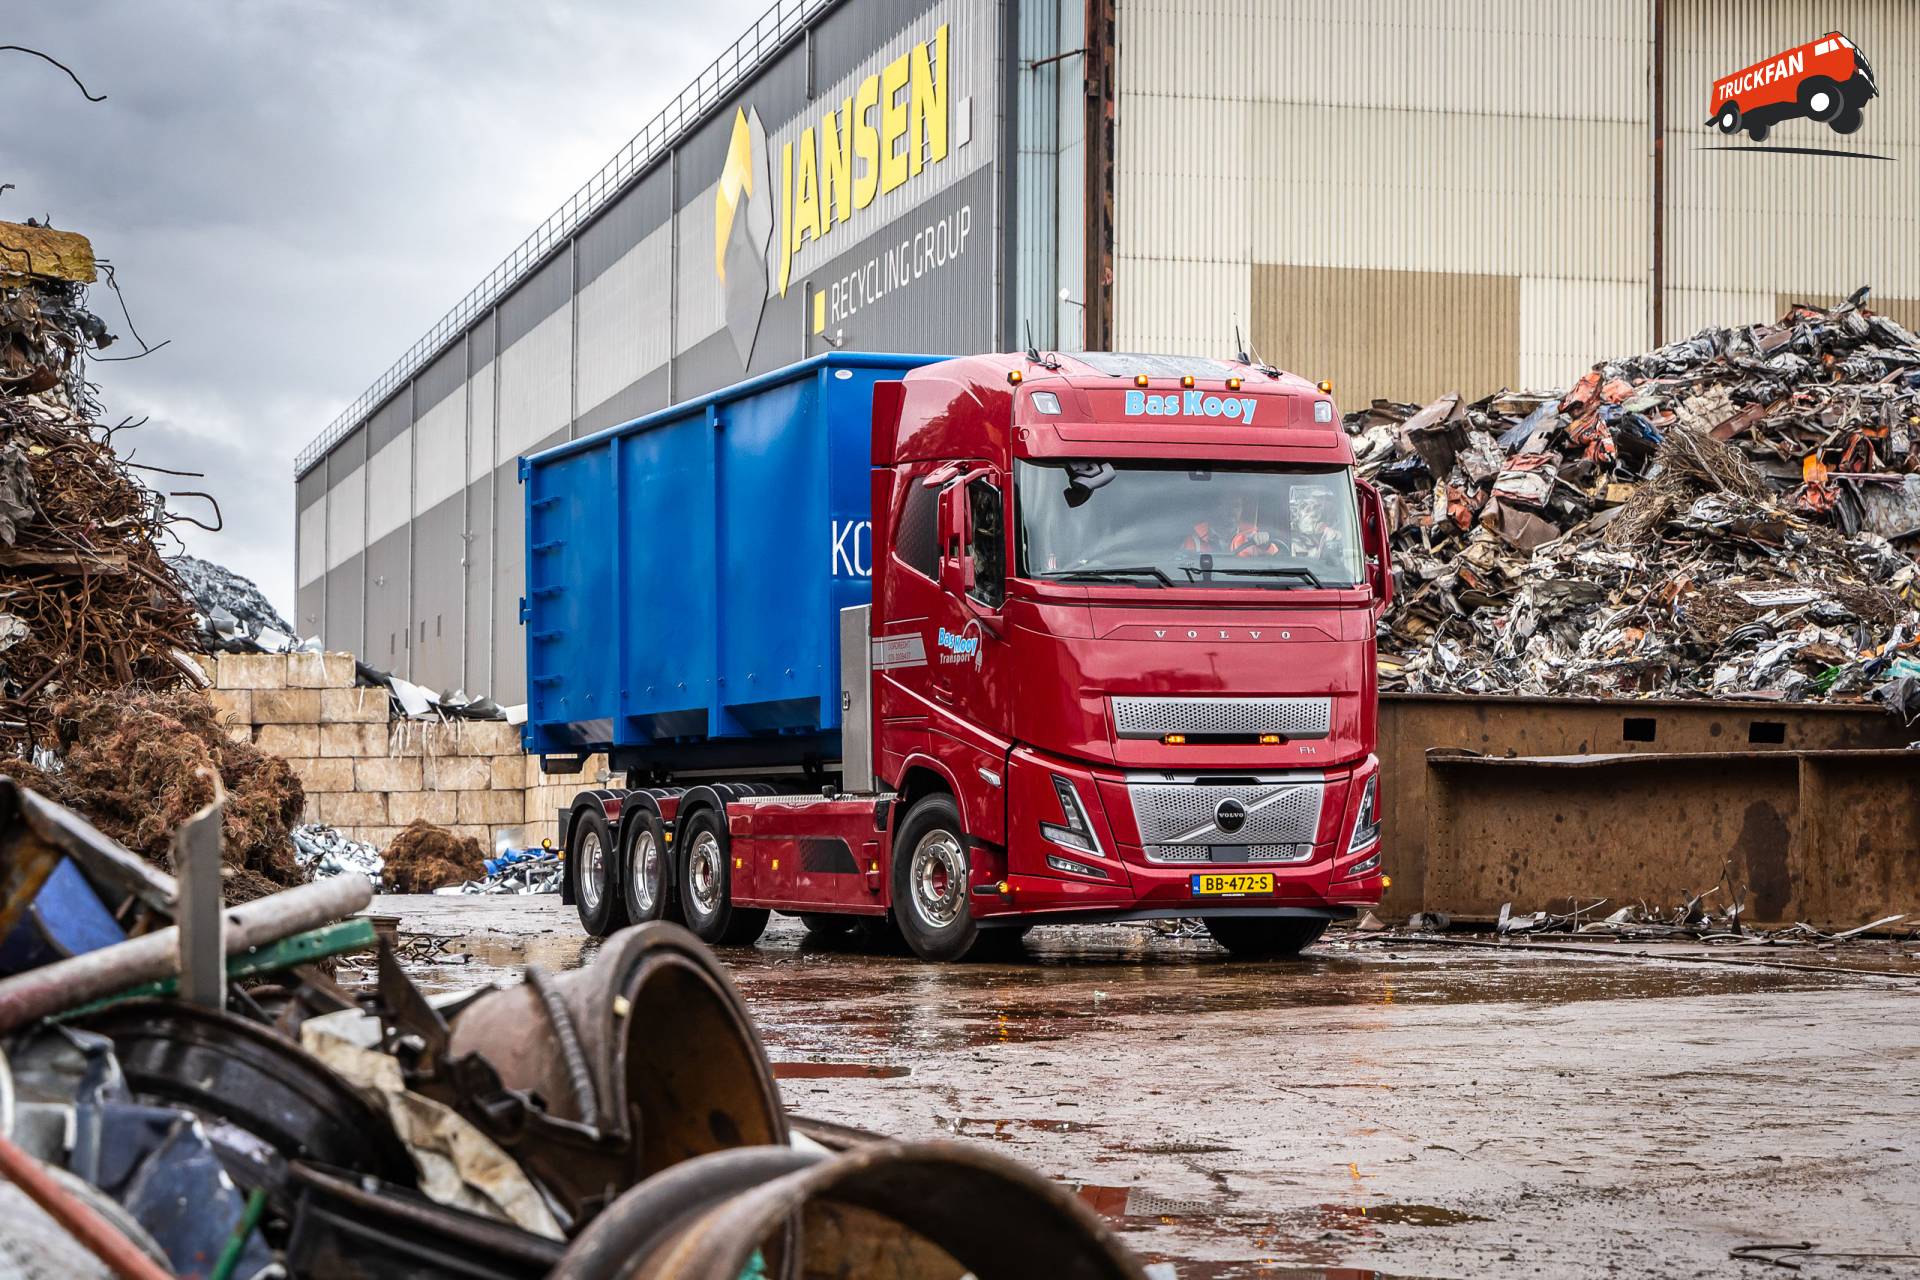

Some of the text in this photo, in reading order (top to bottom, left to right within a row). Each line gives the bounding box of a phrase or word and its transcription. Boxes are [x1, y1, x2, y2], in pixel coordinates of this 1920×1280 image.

[831, 205, 971, 325] RECYCLING GROUP
[1124, 390, 1257, 425] Bas Kooy
[938, 627, 979, 657] Bas Kooy
[1154, 629, 1292, 640] VOLVO
[939, 652, 971, 666] Transport
[1299, 746, 1316, 755] FH
[1205, 876, 1268, 891] BB-472-S
